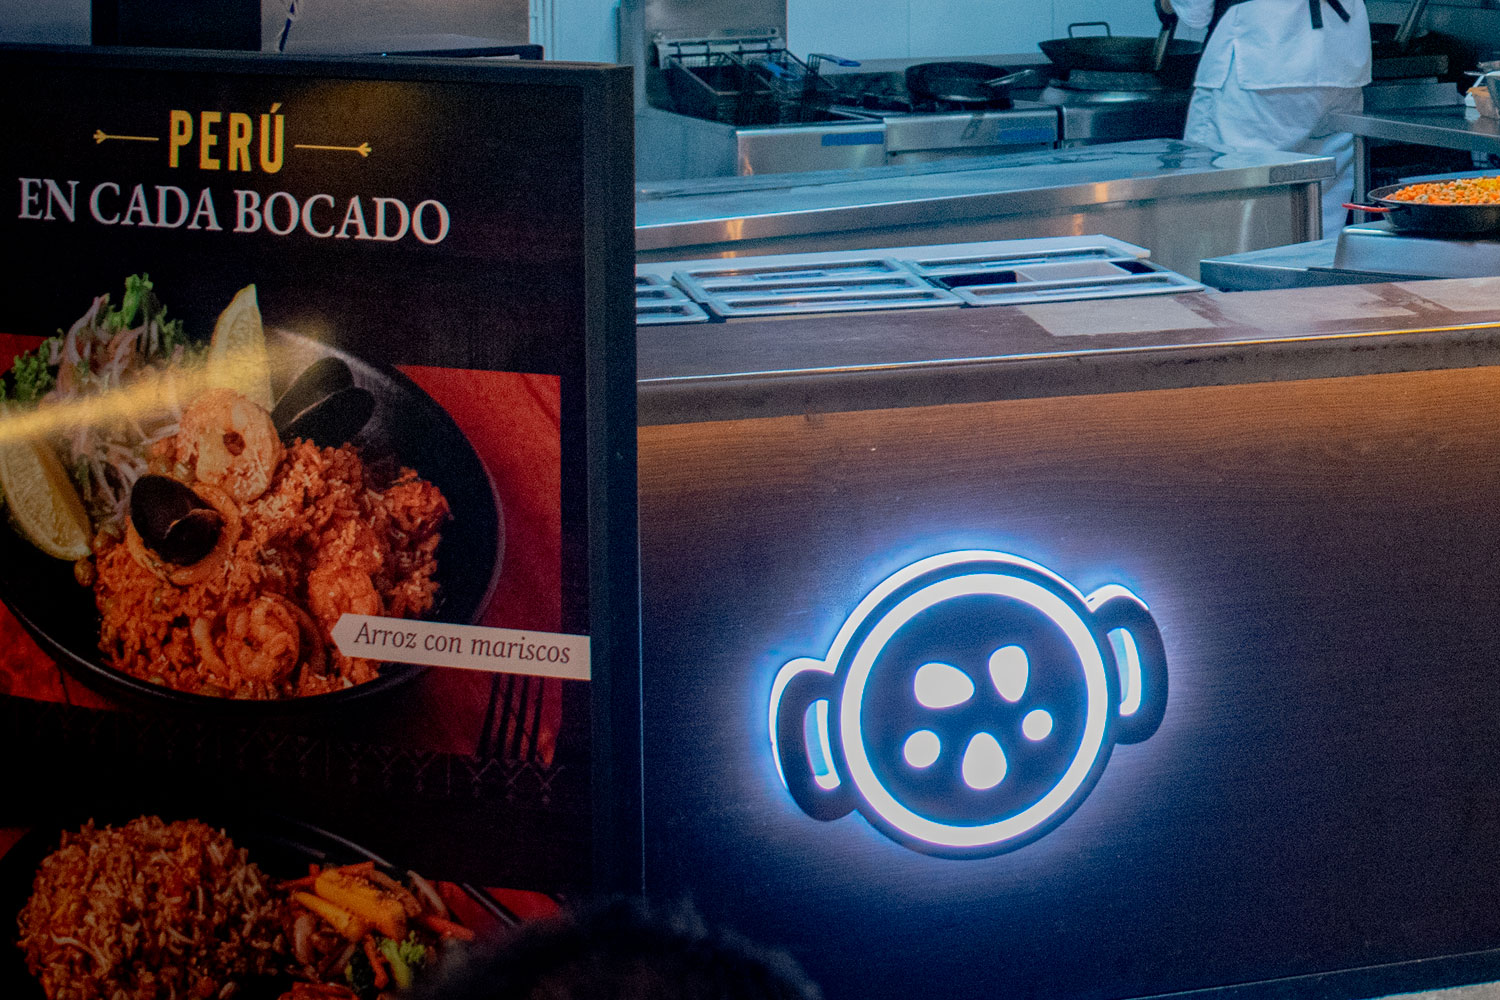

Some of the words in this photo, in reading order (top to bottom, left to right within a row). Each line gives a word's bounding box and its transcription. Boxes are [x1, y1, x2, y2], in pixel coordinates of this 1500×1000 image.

[168, 102, 285, 174] PERÚ
[17, 176, 80, 222] EN
[89, 181, 223, 232] CADA
[233, 188, 450, 245] BOCADO
[353, 621, 418, 649] Arroz
[424, 633, 463, 654] con
[470, 636, 571, 665] mariscos
